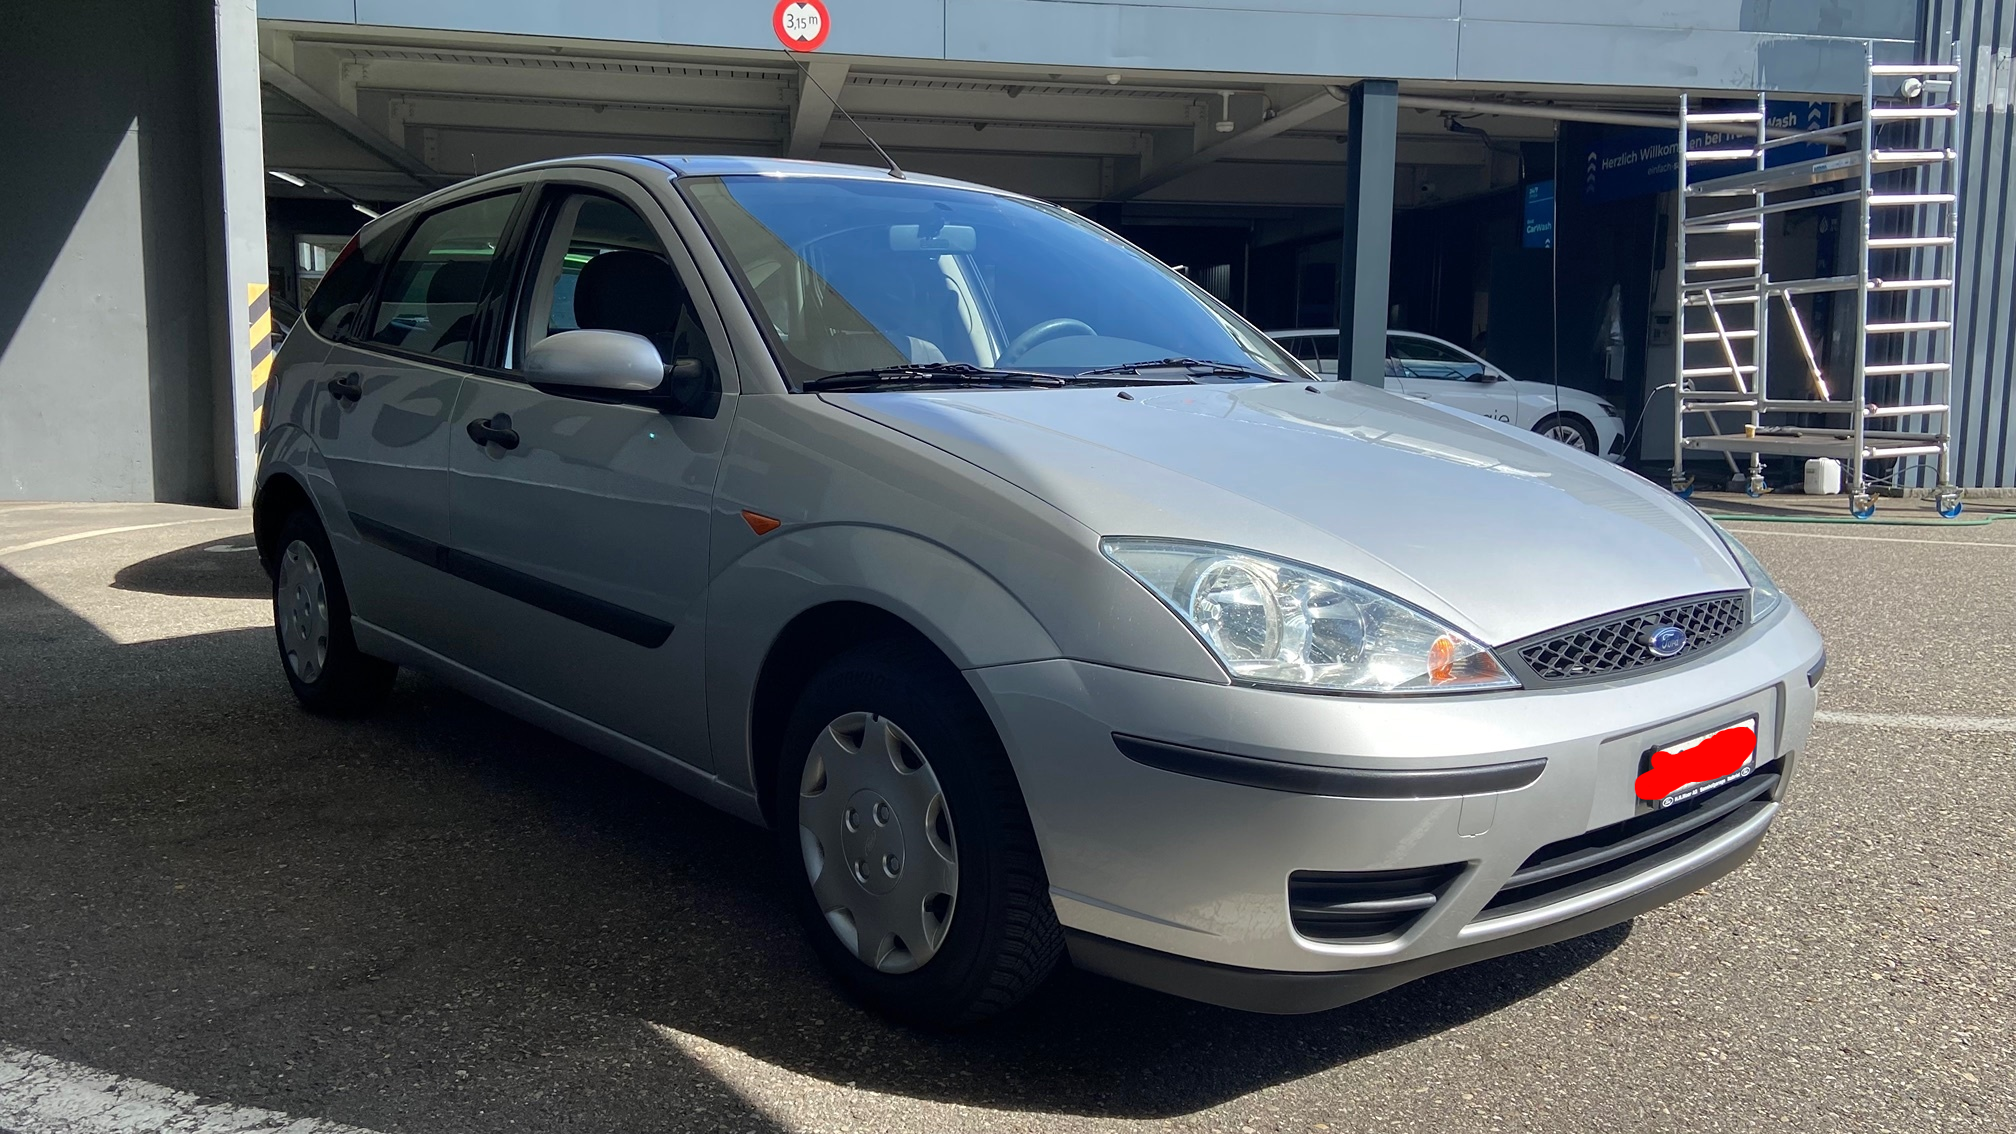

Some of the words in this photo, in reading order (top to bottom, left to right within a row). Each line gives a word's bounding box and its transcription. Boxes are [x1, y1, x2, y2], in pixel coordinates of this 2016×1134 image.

[1602, 150, 1638, 170] Herzlich
[1640, 137, 1702, 161] Willkomen
[1526, 221, 1552, 234] CarWash
[1661, 632, 1679, 650] Ford
